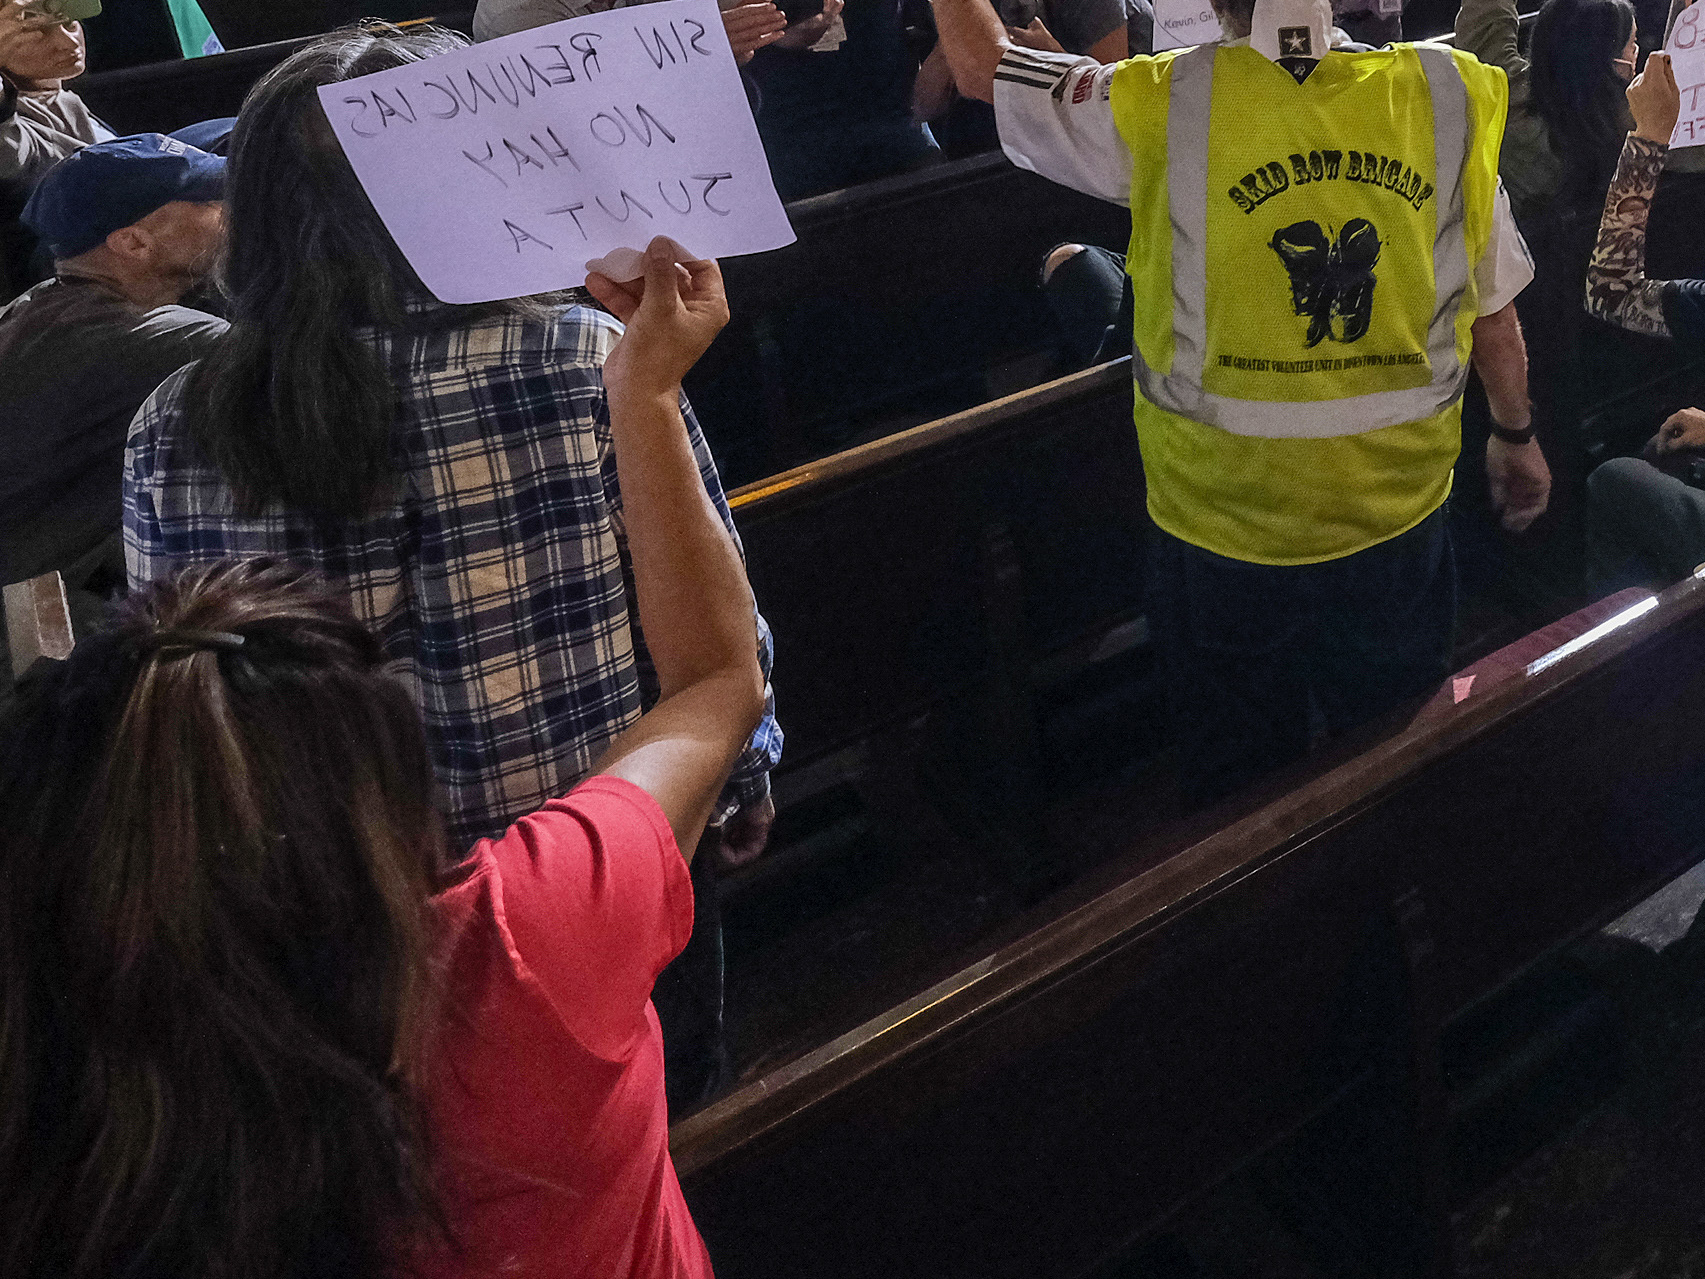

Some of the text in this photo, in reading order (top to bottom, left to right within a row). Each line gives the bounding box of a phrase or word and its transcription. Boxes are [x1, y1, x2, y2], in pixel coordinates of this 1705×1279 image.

[1228, 149, 1434, 214] SKID ROW BRIGADE
